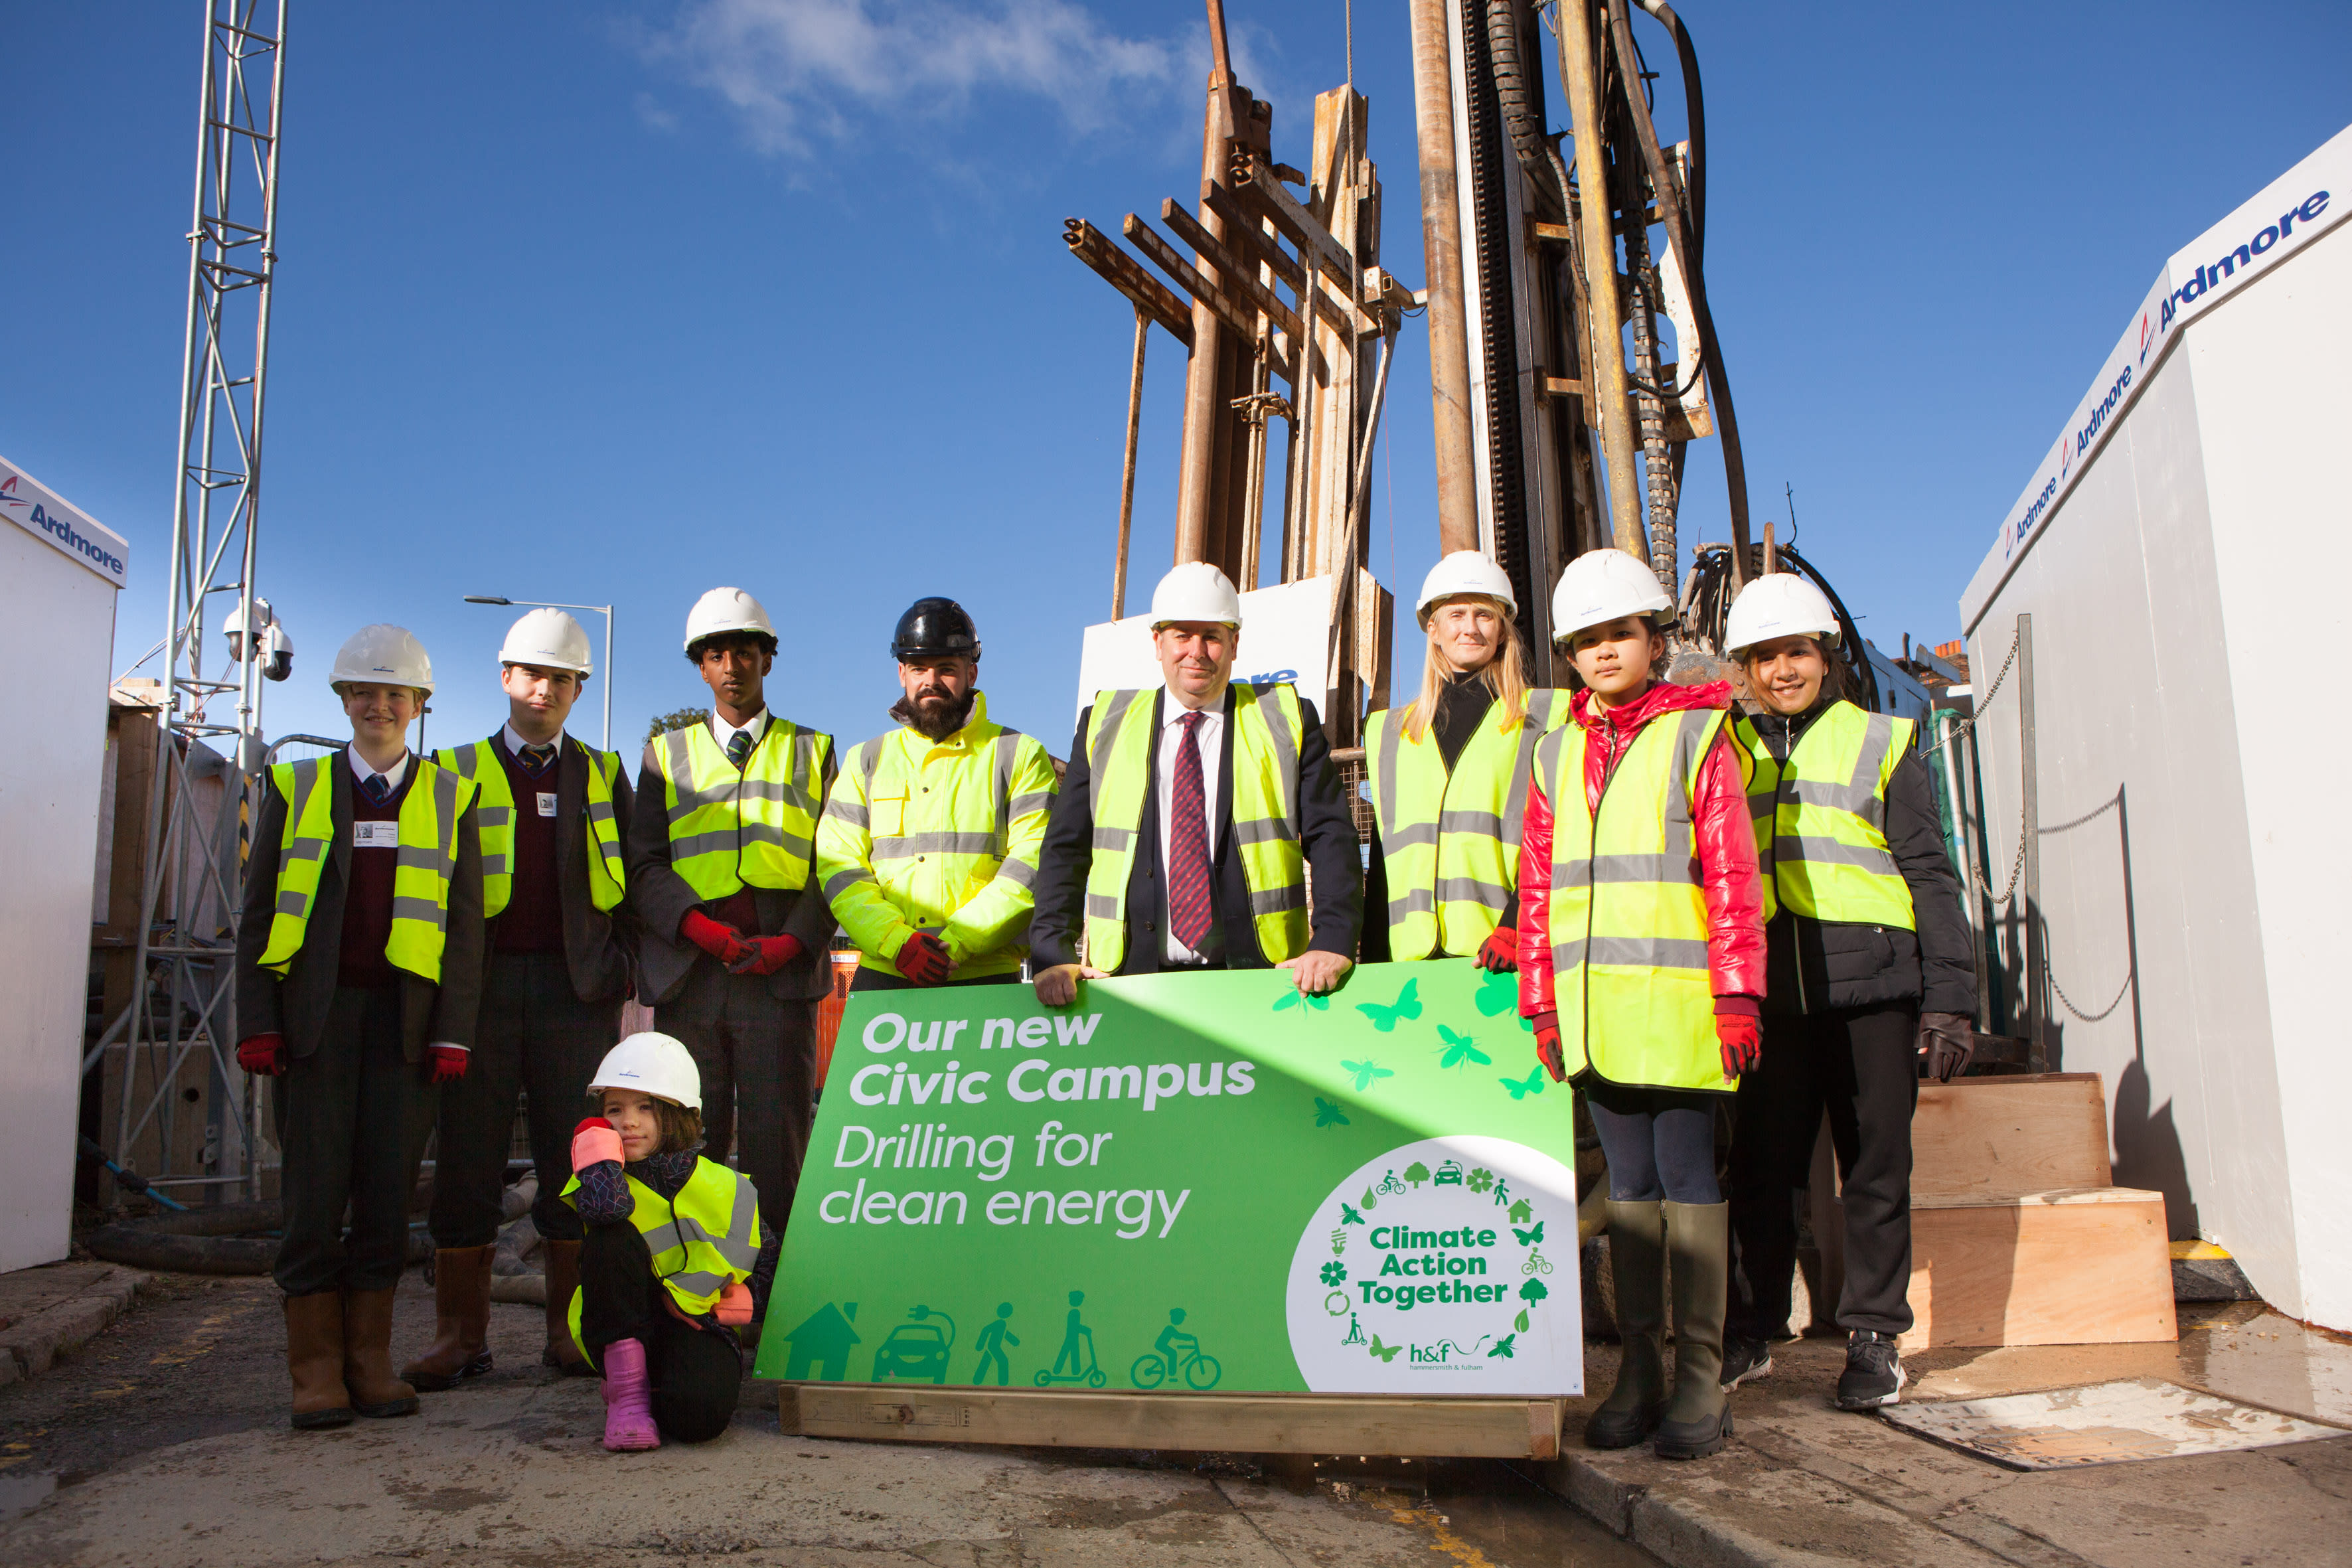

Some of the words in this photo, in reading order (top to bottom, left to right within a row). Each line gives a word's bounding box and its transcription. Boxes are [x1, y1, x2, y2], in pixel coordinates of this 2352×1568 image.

[2161, 190, 2331, 335] Ardmore
[2077, 364, 2132, 458] Ardmore
[2016, 476, 2057, 544] Ardmore
[30, 503, 123, 575] Ardmore
[862, 1012, 968, 1054] Our
[980, 1013, 1103, 1049] new
[850, 1060, 991, 1106] Civic
[1006, 1059, 1256, 1111] Campus
[833, 1123, 1014, 1182] Drilling
[1034, 1120, 1113, 1167] for
[819, 1178, 967, 1225] clean
[986, 1188, 1191, 1239] energy
[1370, 1225, 1497, 1250] Climate
[1379, 1251, 1487, 1277] Action
[1358, 1279, 1508, 1311] Together
[1409, 1343, 1450, 1363] h&f
